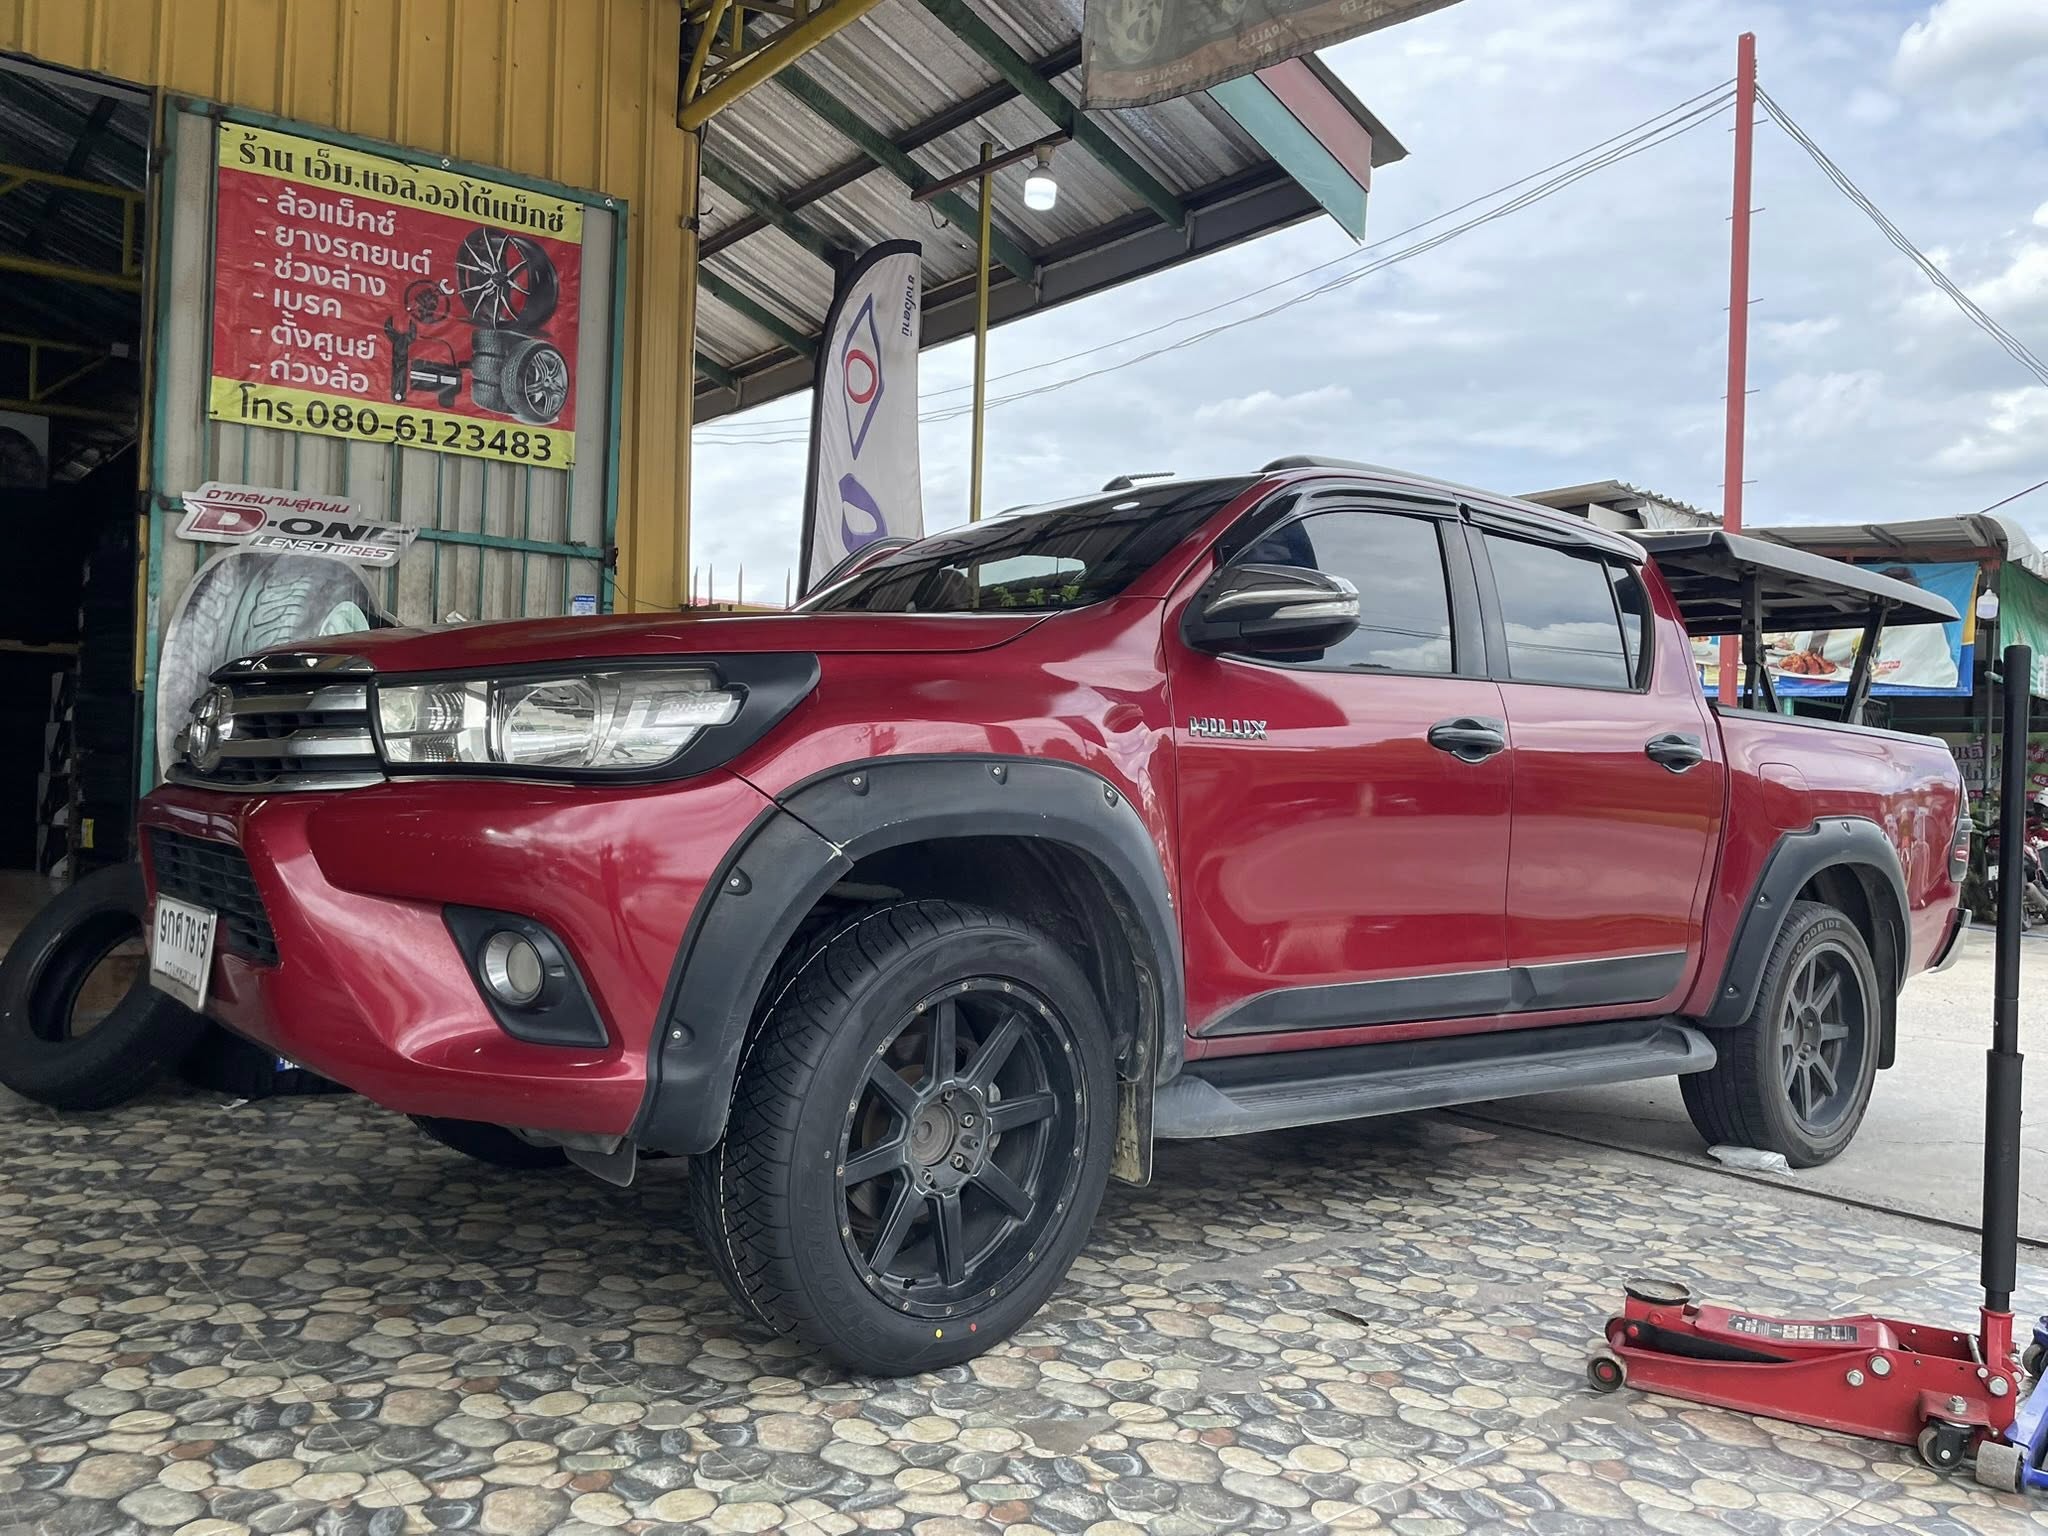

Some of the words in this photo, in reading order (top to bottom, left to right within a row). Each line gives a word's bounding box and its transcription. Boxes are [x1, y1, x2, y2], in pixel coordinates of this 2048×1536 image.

[239, 132, 294, 174] ร้าน
[276, 186, 397, 236] ล้อแม็กซ์
[275, 225, 433, 275] ยางรถยนต์
[274, 251, 387, 297] ช่วงล่าง
[273, 288, 343, 319] เบรค
[270, 310, 377, 362] ตั้งศูนย์
[269, 352, 370, 393] ถ่วงล้อ
[254, 536, 328, 552] LENSO
[329, 543, 396, 559] TIRES
[1188, 716, 1269, 741] HILUX
